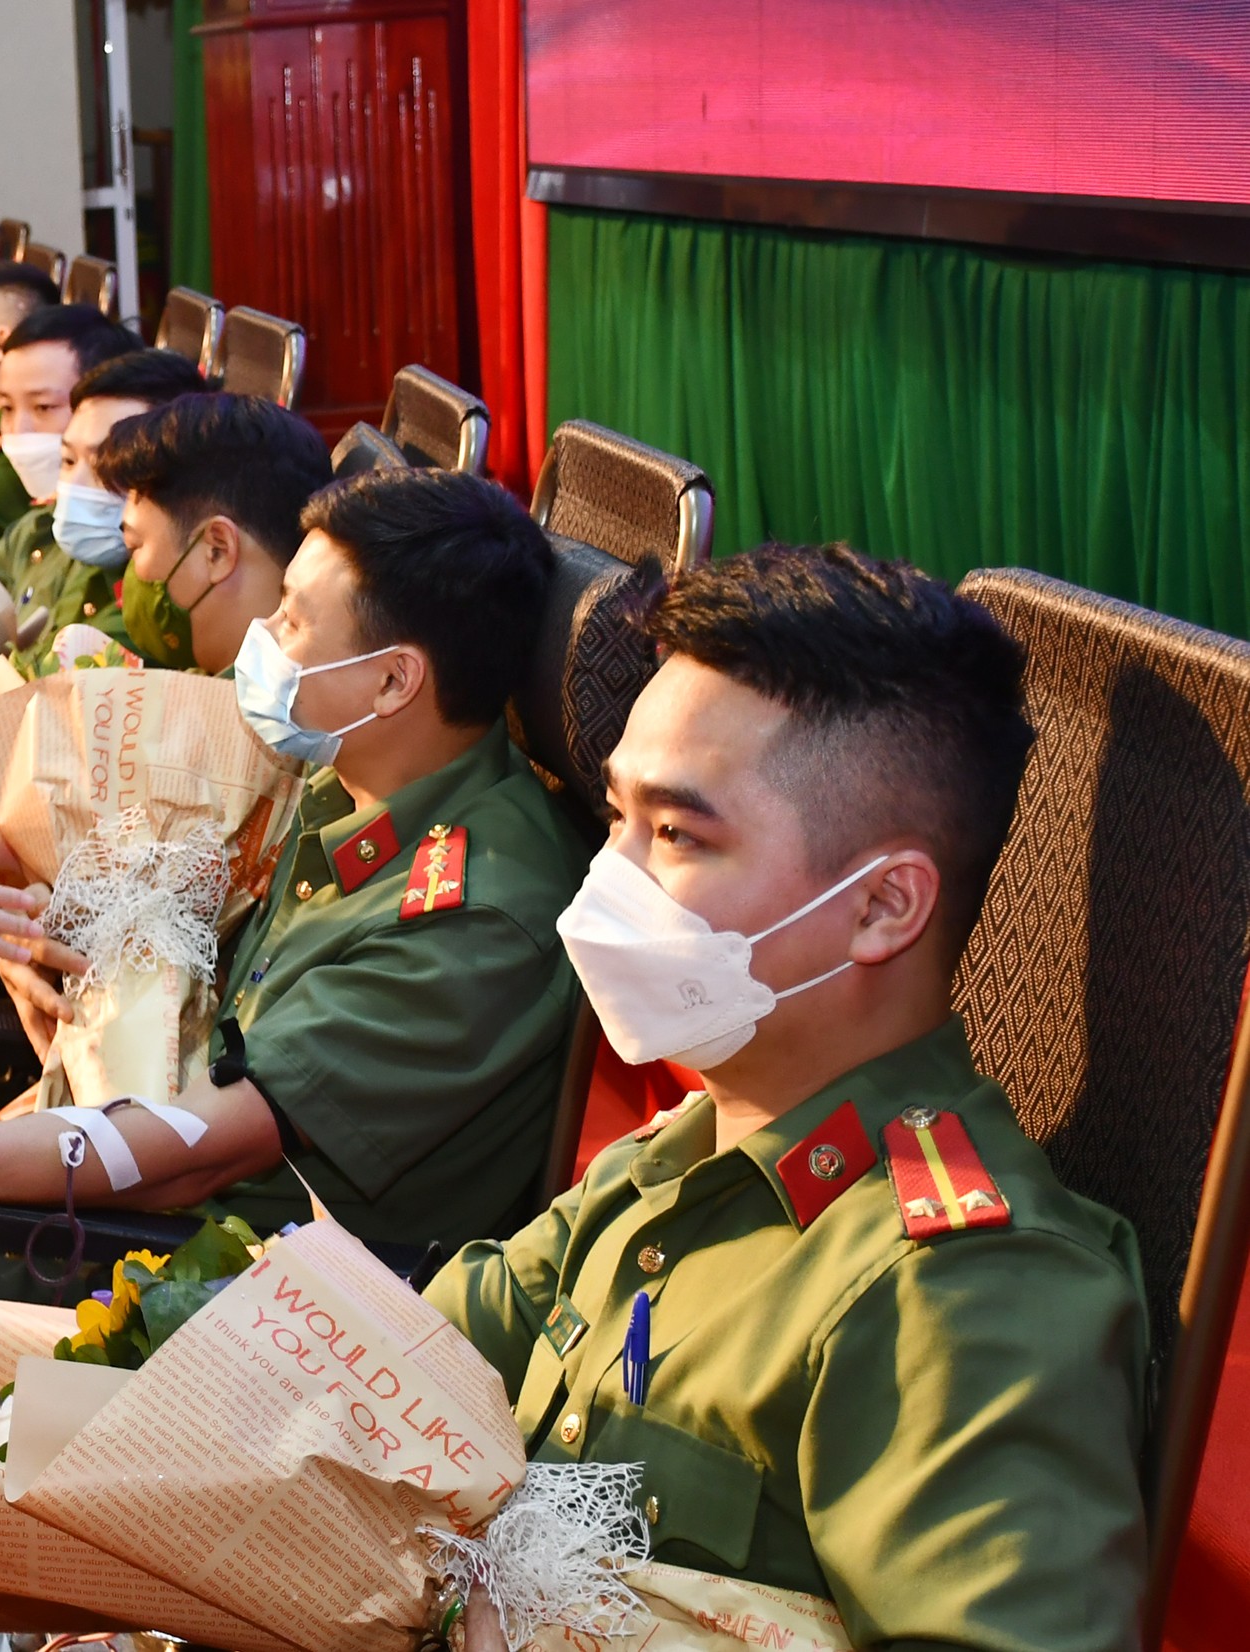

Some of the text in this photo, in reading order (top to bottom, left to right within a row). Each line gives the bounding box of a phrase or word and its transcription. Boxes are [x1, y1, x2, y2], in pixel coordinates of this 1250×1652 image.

[90, 688, 113, 802] YOU FOR
[118, 687, 144, 781] WOULD
[162, 1365, 180, 1380] now
[180, 1379, 197, 1394] and
[168, 1352, 192, 1374] blows
[203, 1383, 220, 1398] and
[179, 1346, 205, 1370] clouds
[200, 1334, 234, 1364] laughter
[233, 1362, 249, 1377] has
[277, 1404, 292, 1419] the
[214, 1318, 251, 1352] think
[248, 1350, 279, 1378] you
[278, 1376, 304, 1402] are
[305, 1399, 331, 1422] the
[328, 1419, 365, 1454] April
[252, 1306, 326, 1376] YOU
[326, 1381, 401, 1461] FOR
[274, 1276, 402, 1400] WOULD
[399, 1397, 482, 1474] LIKE
[231, 1376, 248, 1392] with
[247, 1391, 262, 1405] the
[135, 1409, 154, 1426] over
[153, 1424, 175, 1443] each
[159, 1412, 177, 1427] and
[162, 1398, 177, 1411] are
[176, 1410, 211, 1440] crowned
[210, 1438, 229, 1454] with
[166, 1384, 181, 1397] the
[247, 1453, 264, 1468] and
[69, 1495, 85, 1510] this
[114, 1443, 137, 1464] white
[199, 1521, 220, 1539] your
[123, 1432, 157, 1465] budding
[195, 1498, 210, 1512] are
[210, 1510, 225, 1524] the
[138, 1428, 155, 1444] that
[153, 1441, 173, 1460] light
[213, 1494, 231, 1512] look
[230, 1509, 246, 1525] like
[95, 1501, 118, 1522] warm
[101, 1487, 150, 1531] between the
[162, 1505, 215, 1554] the blooming
[278, 1498, 311, 1527] summer
[310, 1526, 331, 1544] shall
[329, 1542, 344, 1556] not
[213, 1567, 231, 1584] took
[230, 1582, 245, 1596] the
[242, 1537, 260, 1555] Two
[258, 1553, 282, 1575] roads
[280, 1573, 316, 1605] diverged
[245, 1576, 259, 1589] far
[259, 1518, 288, 1543] eternal
[332, 1582, 351, 1600] thou
[263, 1541, 285, 1560] eyes
[284, 1557, 300, 1573] can
[300, 1535, 322, 1554] shall
[319, 1552, 343, 1574] death
[341, 1572, 361, 1591] brag
[349, 1542, 385, 1576] changing
